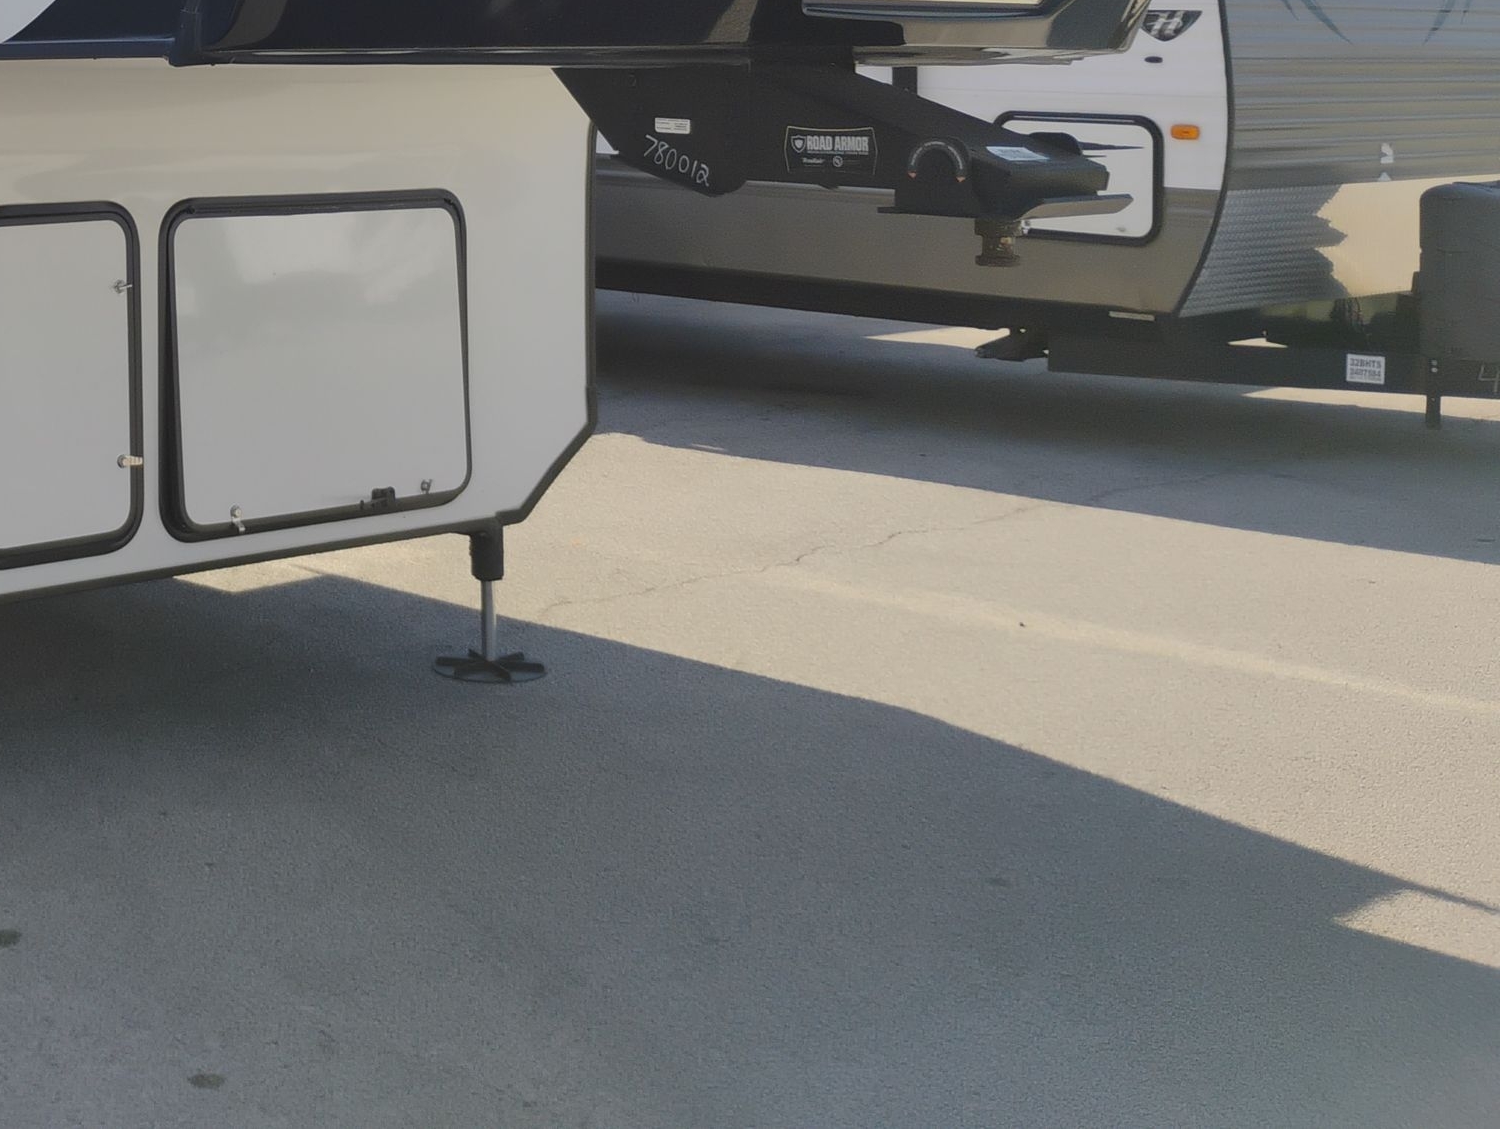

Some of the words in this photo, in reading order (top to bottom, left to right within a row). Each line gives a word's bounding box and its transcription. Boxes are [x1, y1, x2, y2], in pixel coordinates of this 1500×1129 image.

[643, 134, 710, 187] 780012
[806, 135, 833, 151] ROAD
[834, 135, 870, 152] ARMOR
